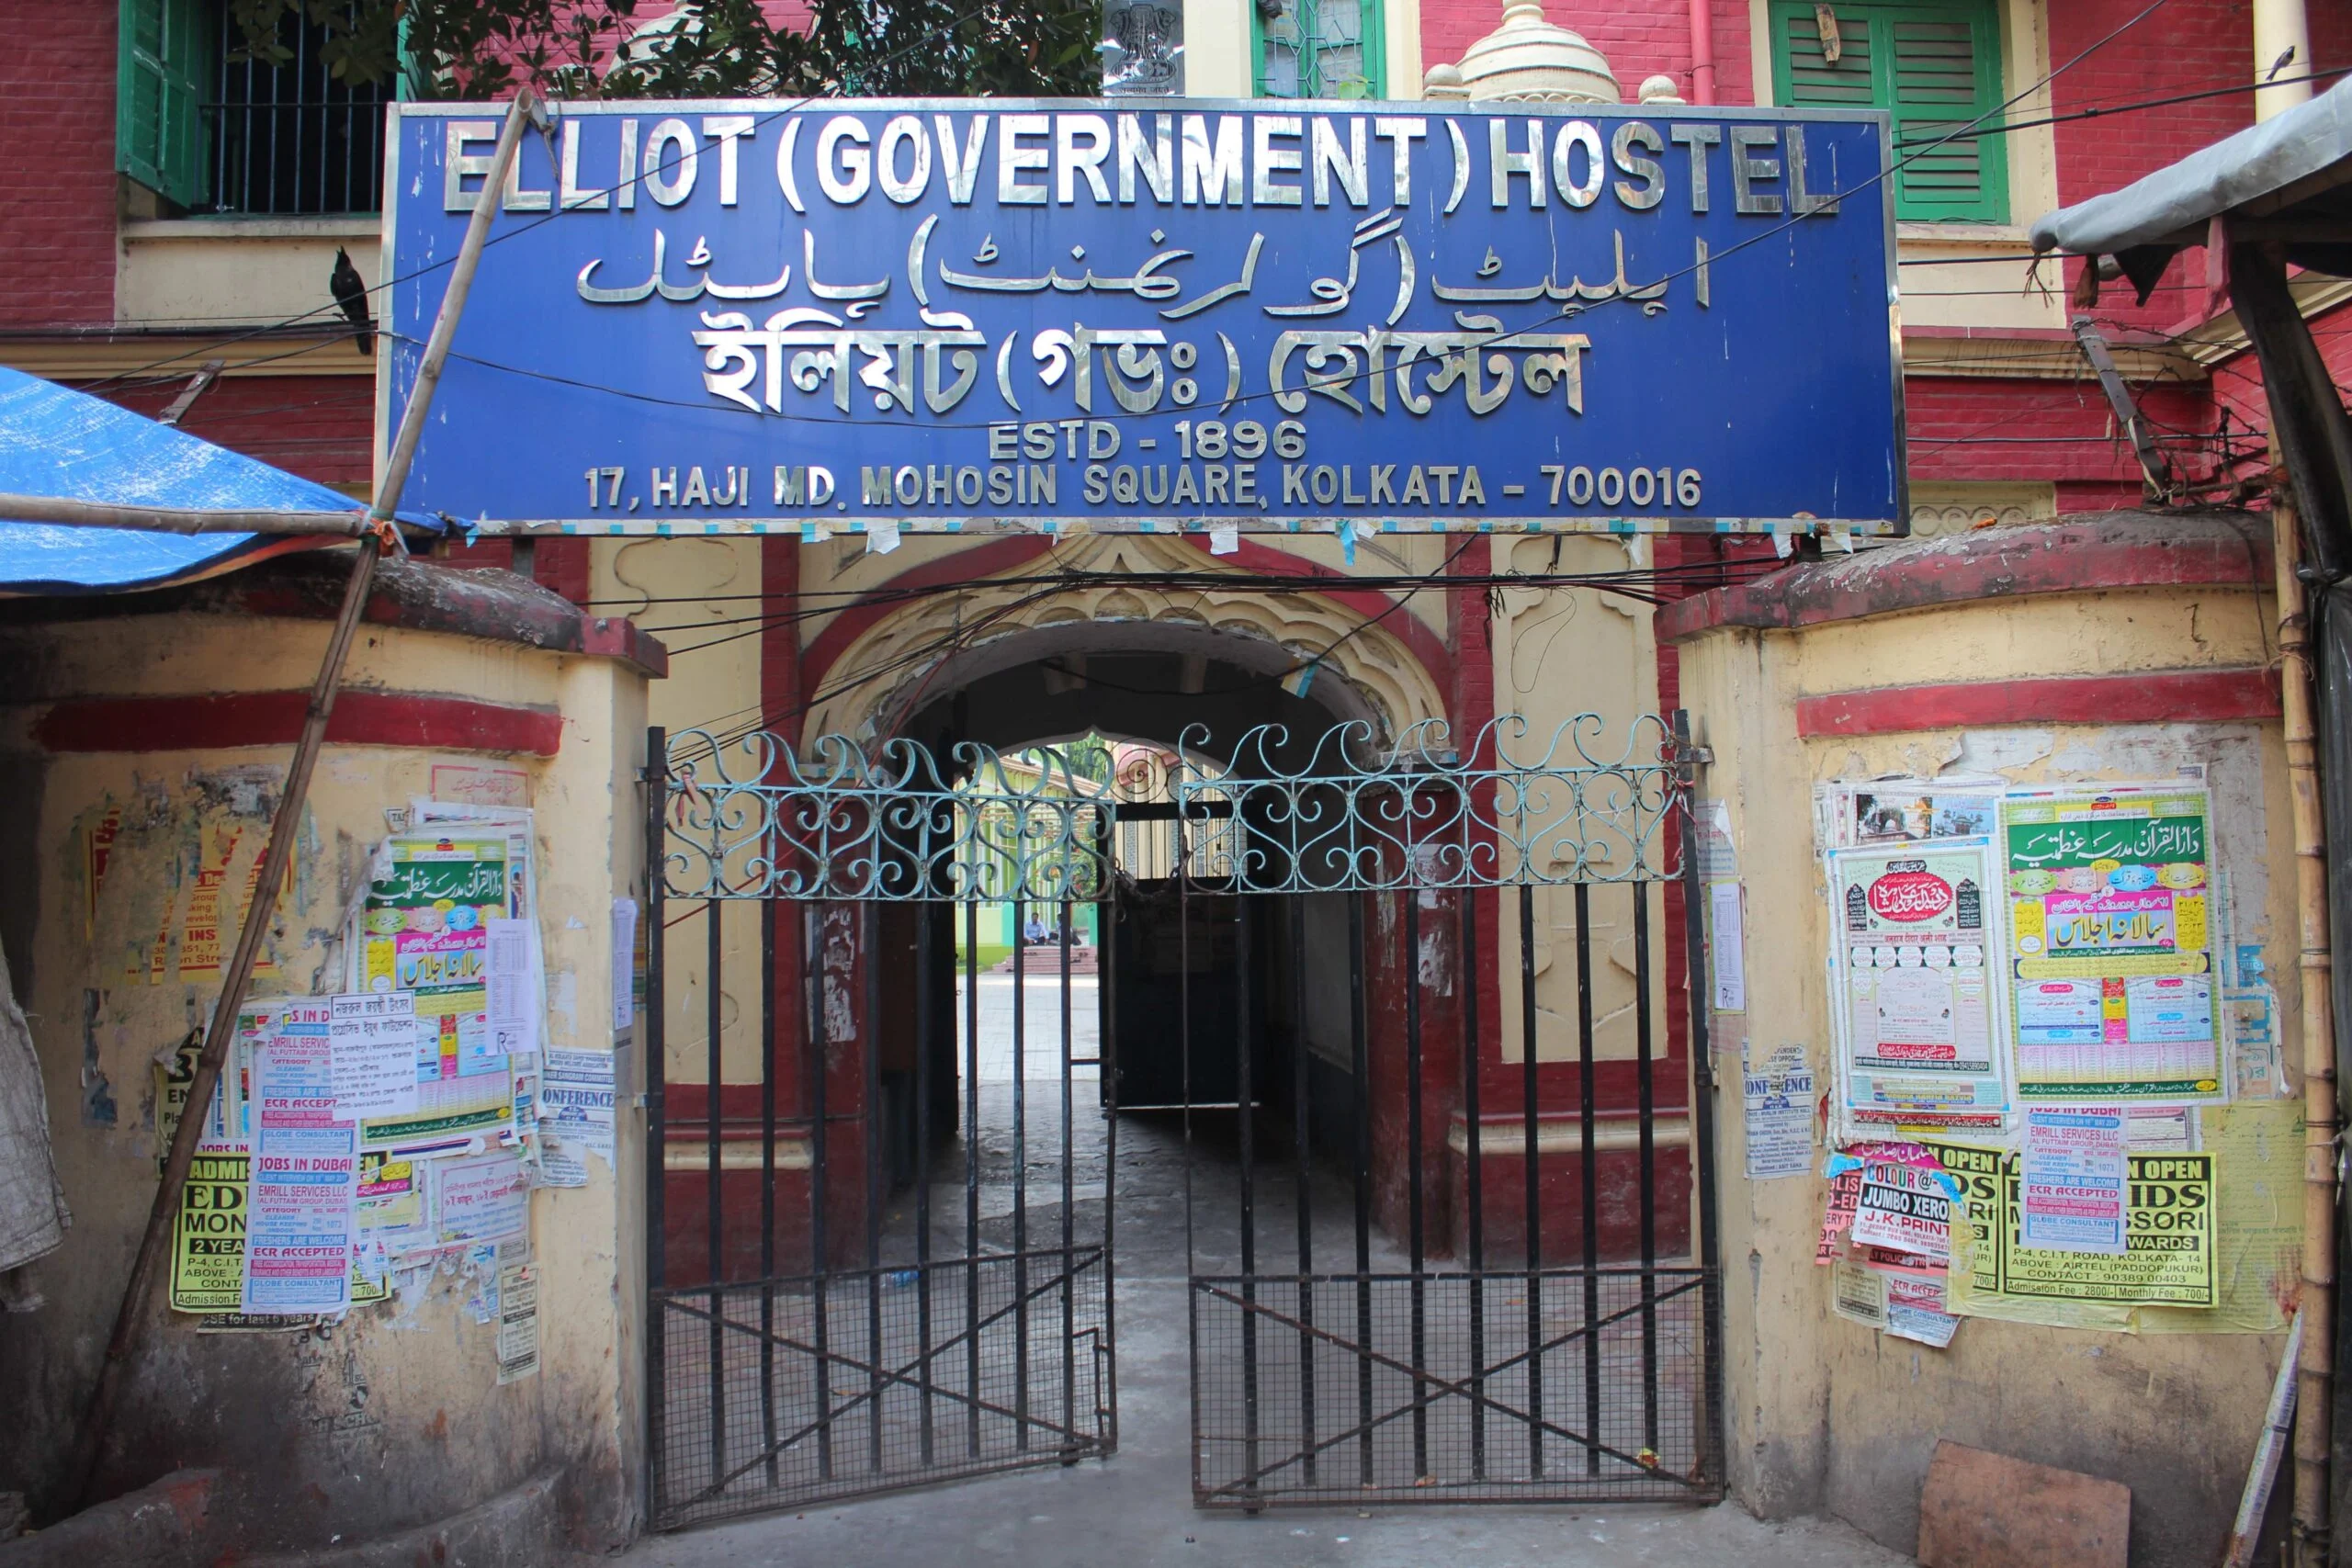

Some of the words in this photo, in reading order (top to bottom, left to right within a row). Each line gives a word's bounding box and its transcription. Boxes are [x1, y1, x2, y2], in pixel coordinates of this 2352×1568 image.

[444, 116, 756, 212] ELLIOT
[776, 114, 1470, 213] (GOVERNMENT)
[1489, 119, 1839, 214] HOSTEL
[691, 307, 987, 414] ইলিয়ট
[1269, 310, 1592, 416] হোস্টেল
[988, 419, 1122, 460] ESTD
[1174, 420, 1307, 459] 1896
[584, 466, 640, 512] 17,
[651, 466, 750, 507] HAJI
[774, 465, 846, 512] MD.
[861, 464, 1057, 506] MOHOSIN
[1082, 463, 1268, 510] SQUARE,
[1283, 464, 1487, 506] KOLKATA
[1540, 465, 1702, 507] 700016
[265, 1099, 288, 1109] ECR
[2030, 1126, 2060, 1139] EMRILL
[2061, 1127, 2101, 1141] SERVICES
[2102, 1130, 2119, 1141] LLC
[2041, 1138, 2070, 1146] FUTTAIM
[2034, 1147, 2073, 1156] CATEGORY
[258, 1157, 290, 1172] JOBS
[294, 1158, 308, 1171] IN
[311, 1158, 352, 1172] DUBAI
[1943, 1148, 1994, 1174] OPEN
[189, 1160, 251, 1180] ADMI
[1867, 1165, 1916, 1190] COLOUR
[2143, 1160, 2203, 1180] OPEN
[2029, 1174, 2065, 1185] FRESHERS
[2065, 1176, 2081, 1185] ARE
[2080, 1177, 2119, 1189] WELCOME
[186, 1185, 249, 1210] ED
[258, 1184, 288, 1197] EMRILL
[290, 1185, 331, 1198] SERVICES
[333, 1185, 348, 1197] LLC
[2029, 1185, 2052, 1195] ECR
[2054, 1187, 2119, 1199] ACCEPTED
[1863, 1186, 1910, 1213] JUMBO
[2030, 1215, 2059, 1224] GLOBE
[2059, 1217, 2115, 1228] CONSULTANT
[194, 1239, 206, 1253] 2
[254, 1247, 277, 1257] ECR
[281, 1247, 345, 1257] ACCEPTED
[2187, 1254, 2200, 1263] 14
[185, 1269, 228, 1278] ABOVE
[2011, 1258, 2052, 1269] ABOVE
[2063, 1260, 2107, 1271] AIRTEL
[2109, 1262, 2204, 1275] (PADDOPUKUR)
[201, 1279, 243, 1288] CONT
[254, 1279, 283, 1287] GLOBE
[284, 1279, 340, 1287] CONSULTANT
[2027, 1269, 2092, 1281] CONTACT
[2102, 1273, 2144, 1283] 90389
[2147, 1274, 2187, 1284] 00403
[177, 1292, 231, 1305] Admission
[2007, 1281, 2057, 1294] Admission
[2058, 1283, 2076, 1294] Fee
[2085, 1285, 2114, 1298] 2800/-
[2118, 1287, 2156, 1301] Monthly
[2157, 1288, 2177, 1299] Fee
[2184, 1288, 2210, 1300] 700/-
